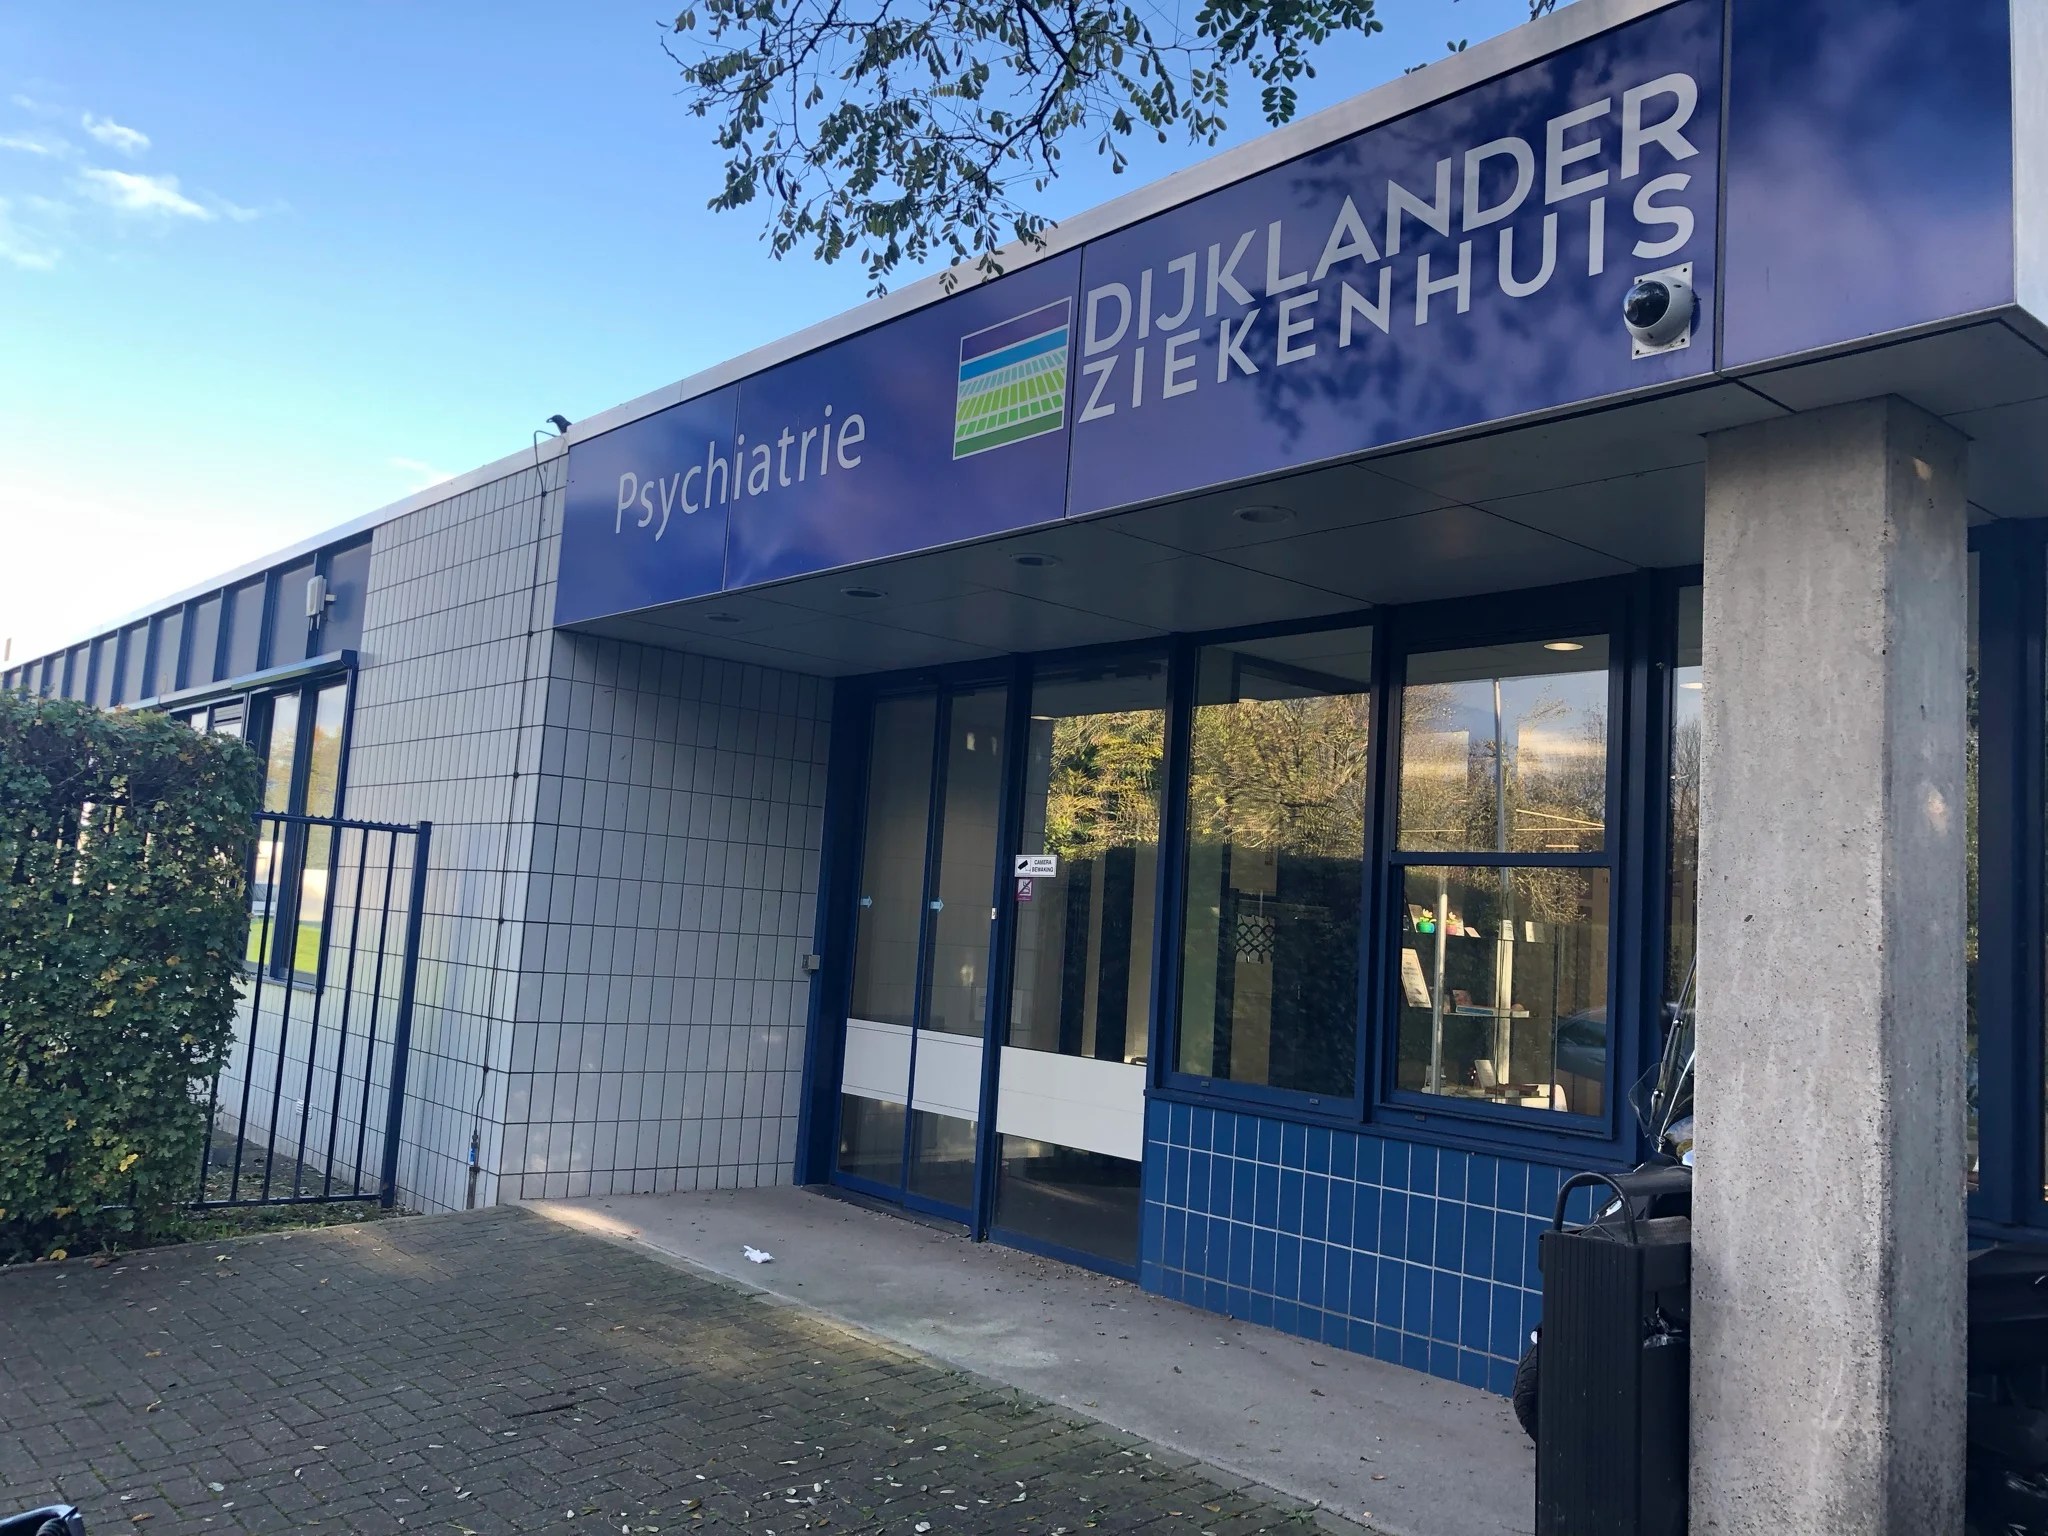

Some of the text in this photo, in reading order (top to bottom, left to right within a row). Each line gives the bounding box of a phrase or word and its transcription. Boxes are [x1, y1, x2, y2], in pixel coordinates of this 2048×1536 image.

[1077, 172, 1696, 424] ZIEKENHUIS
[1083, 72, 1699, 358] DIJKLANDER
[615, 404, 866, 542] Psychiatrie
